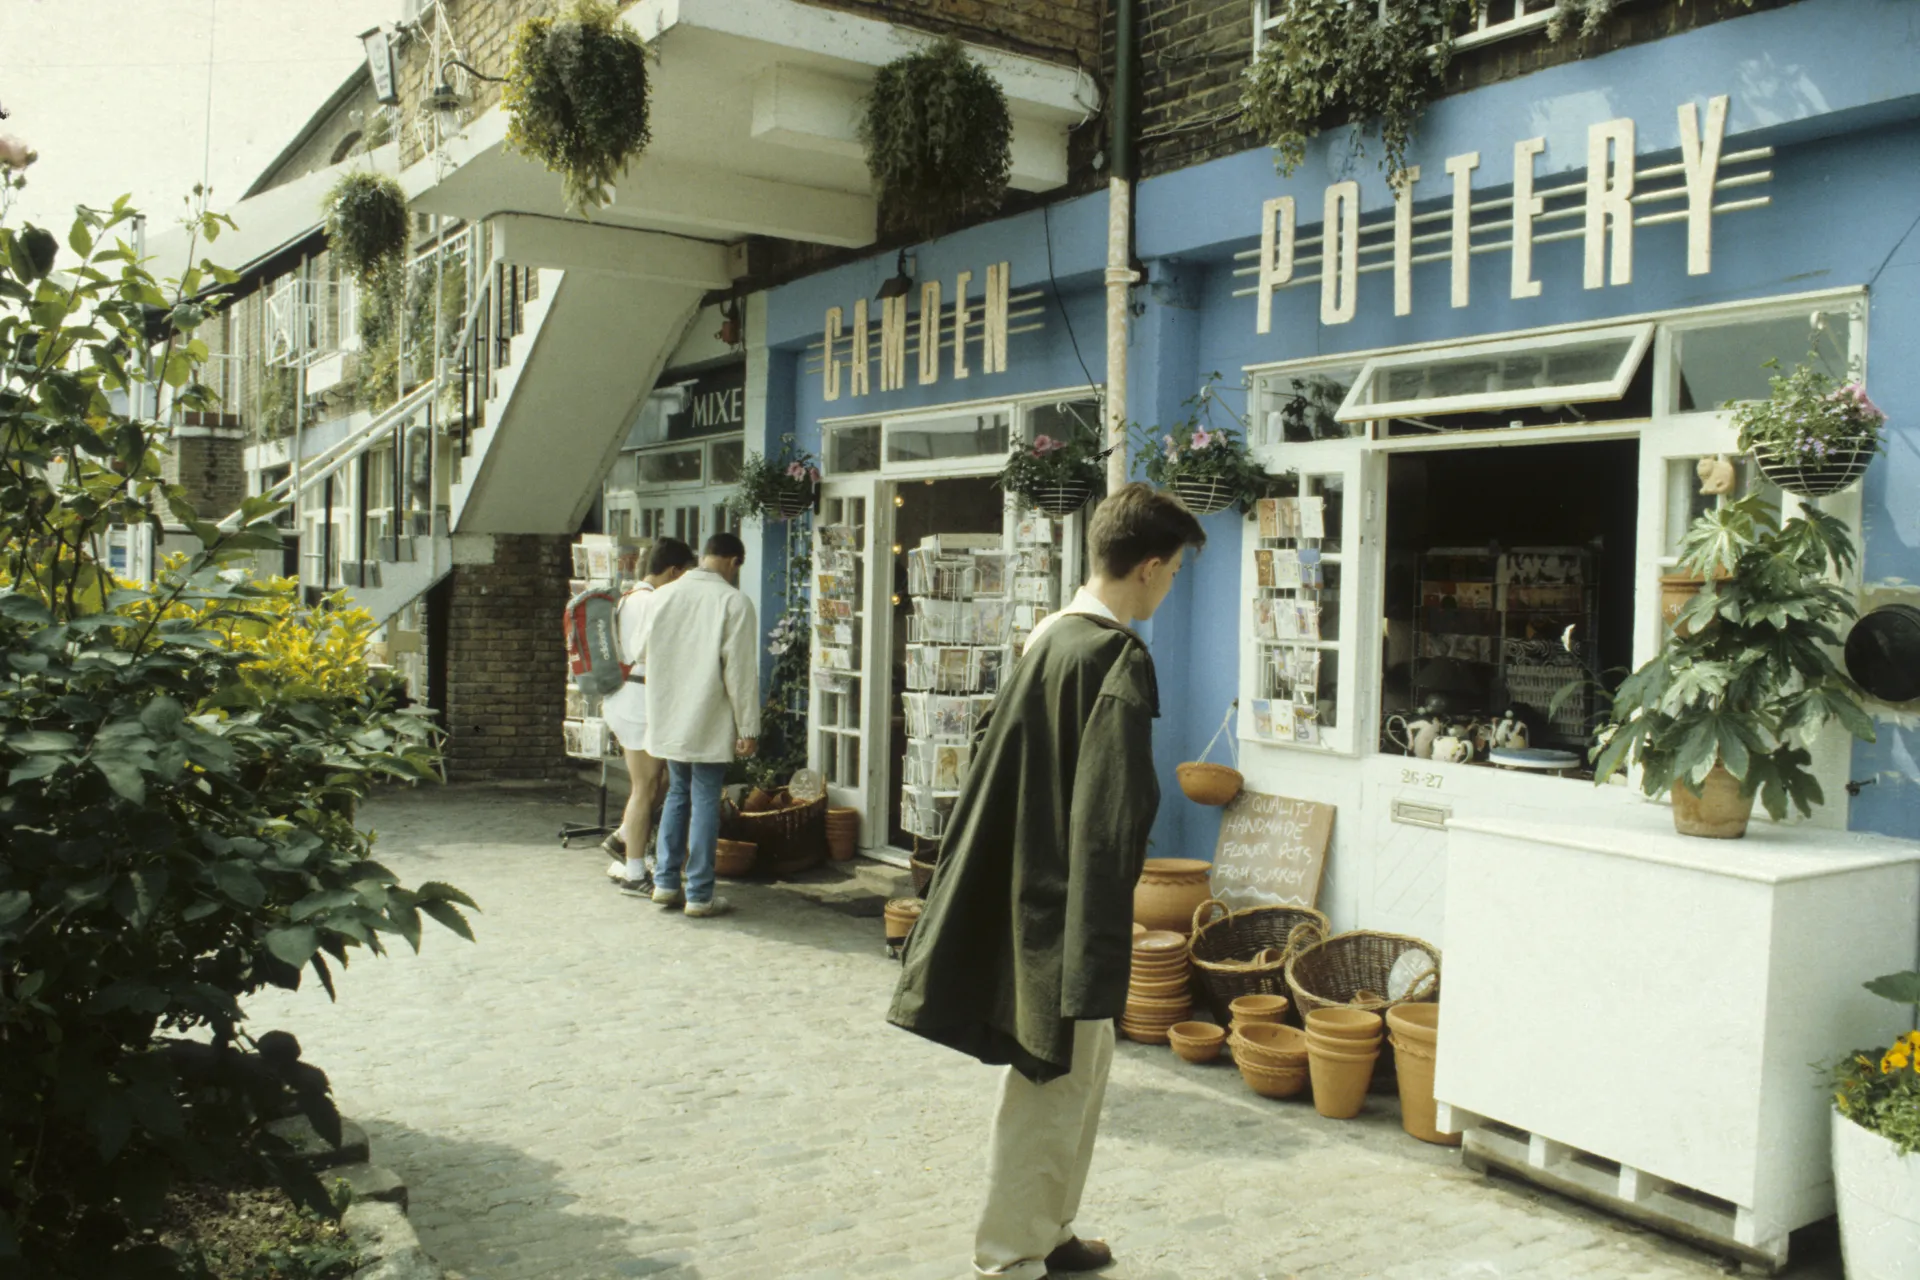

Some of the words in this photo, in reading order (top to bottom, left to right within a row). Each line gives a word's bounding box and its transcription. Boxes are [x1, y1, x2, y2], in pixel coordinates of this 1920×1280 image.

[823, 261, 1011, 402] CAMDEN
[1256, 94, 1729, 334] POTTERY
[1252, 796, 1316, 827] QUALITY
[1226, 814, 1304, 841] HANDMADE
[1222, 841, 1273, 859] FLOWER
[1278, 842, 1313, 865] POTS
[1216, 863, 1251, 880] FROM
